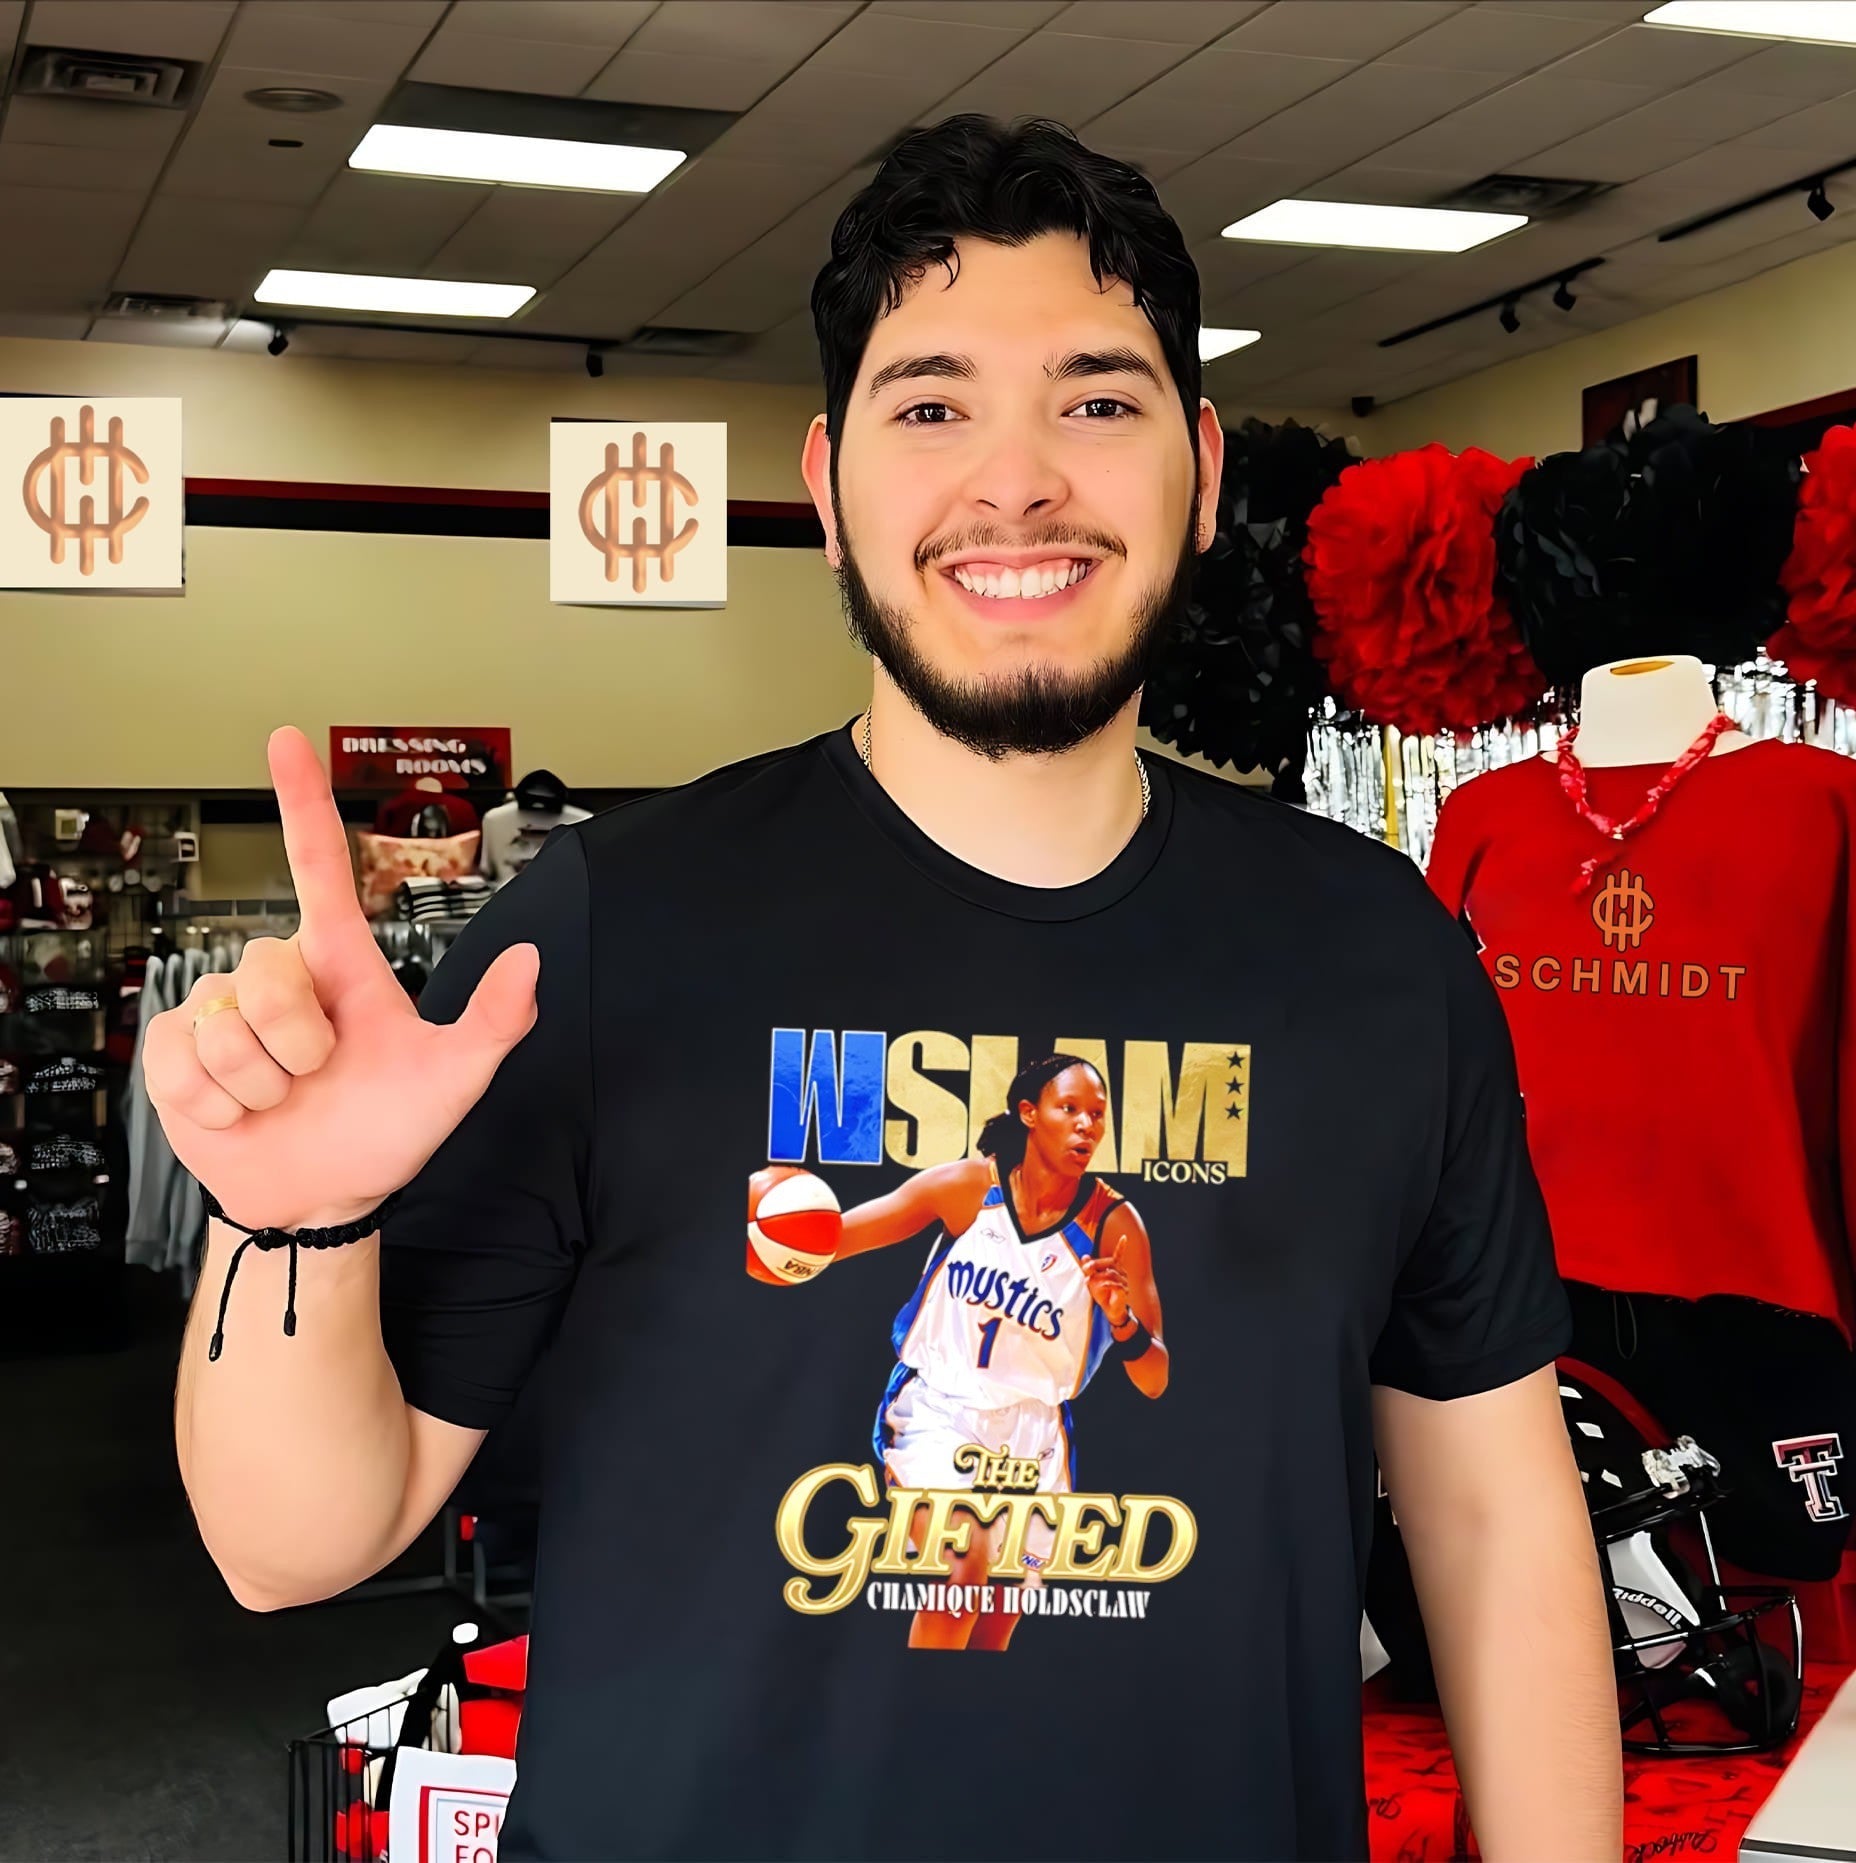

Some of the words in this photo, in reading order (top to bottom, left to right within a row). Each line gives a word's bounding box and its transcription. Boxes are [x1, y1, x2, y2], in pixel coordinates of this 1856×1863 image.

[396, 758, 487, 775] ROOMS
[1494, 954, 1747, 1000] SCHMIDT
[1142, 1160, 1226, 1185] ICONS
[947, 1260, 1065, 1342] mystics
[976, 1316, 1003, 1369] 1
[867, 1581, 995, 1619] CHAMIQUE
[999, 1583, 1151, 1620] HOLDSCLAW
